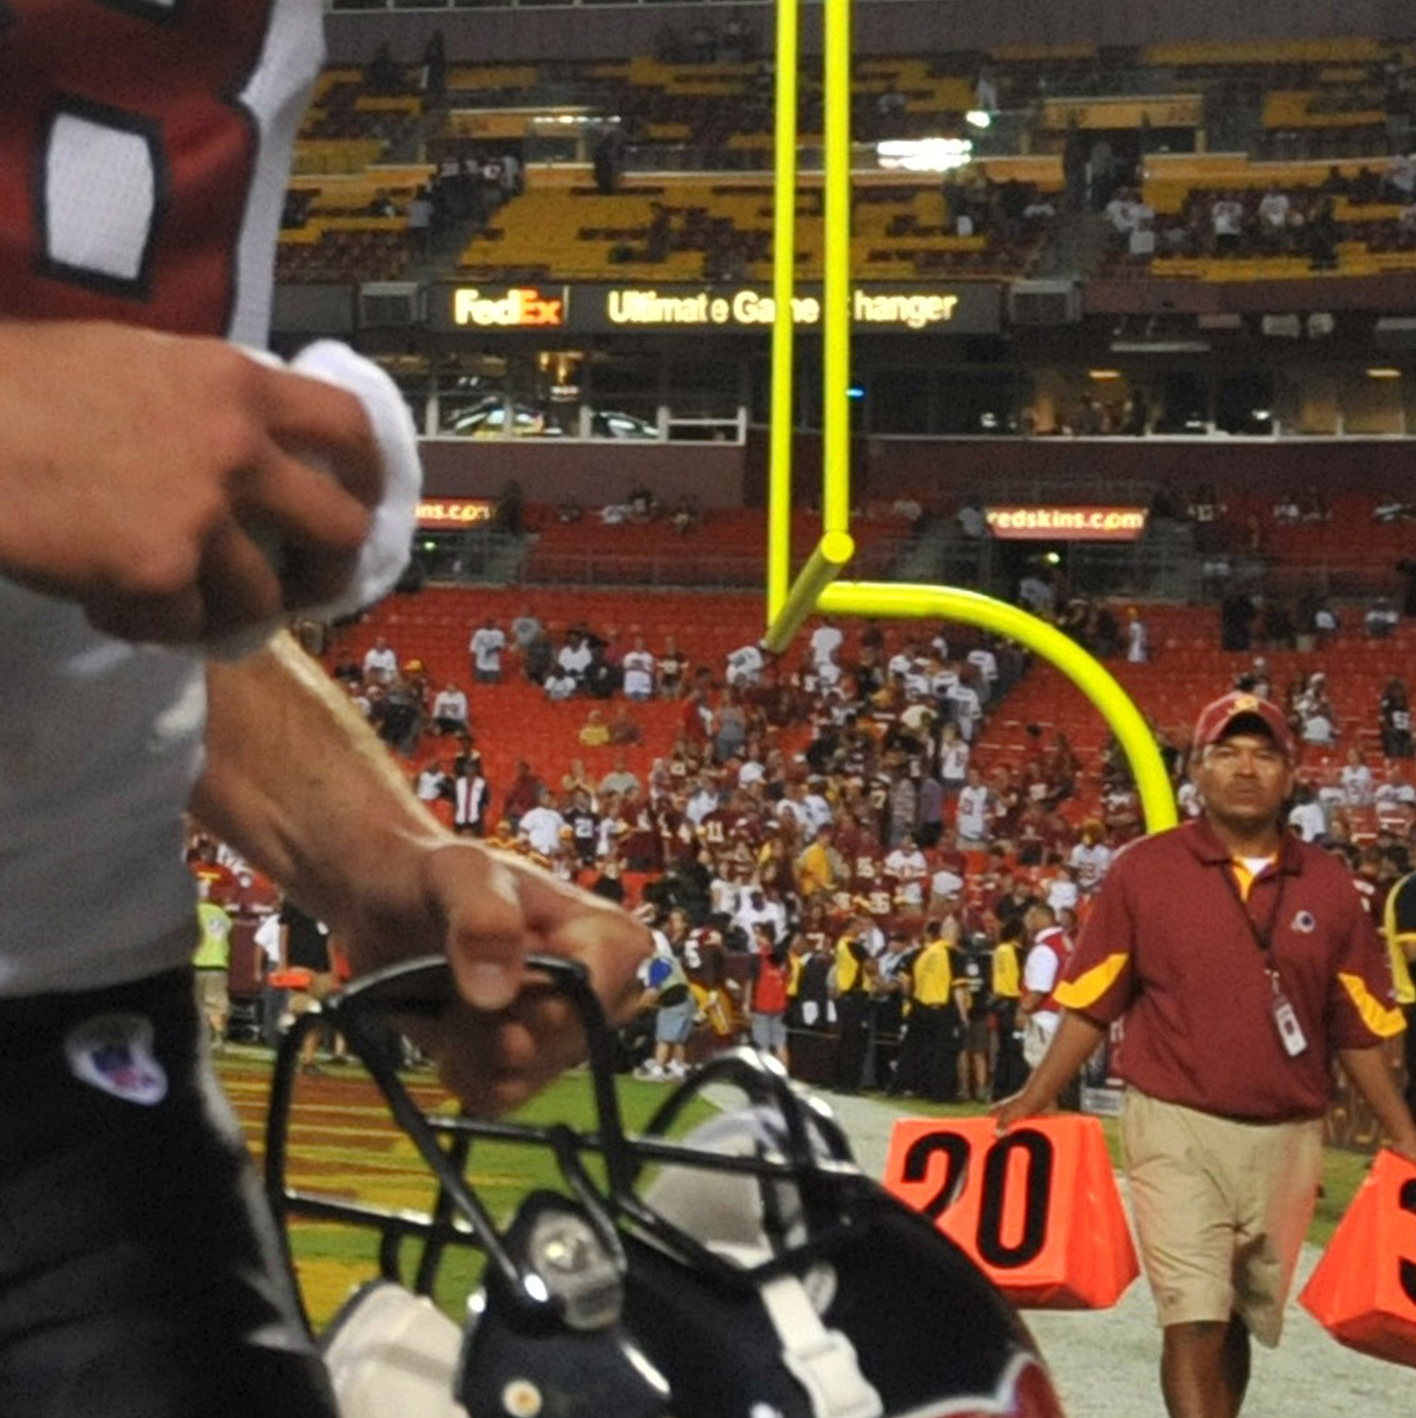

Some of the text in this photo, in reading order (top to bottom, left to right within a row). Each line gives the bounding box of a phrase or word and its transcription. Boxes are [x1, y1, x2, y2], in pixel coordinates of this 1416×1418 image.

[455, 289, 958, 328] FedEx Ultimate Gae hanger
[987, 509, 1144, 529] redskins.com
[902, 1128, 1054, 1269] 20
